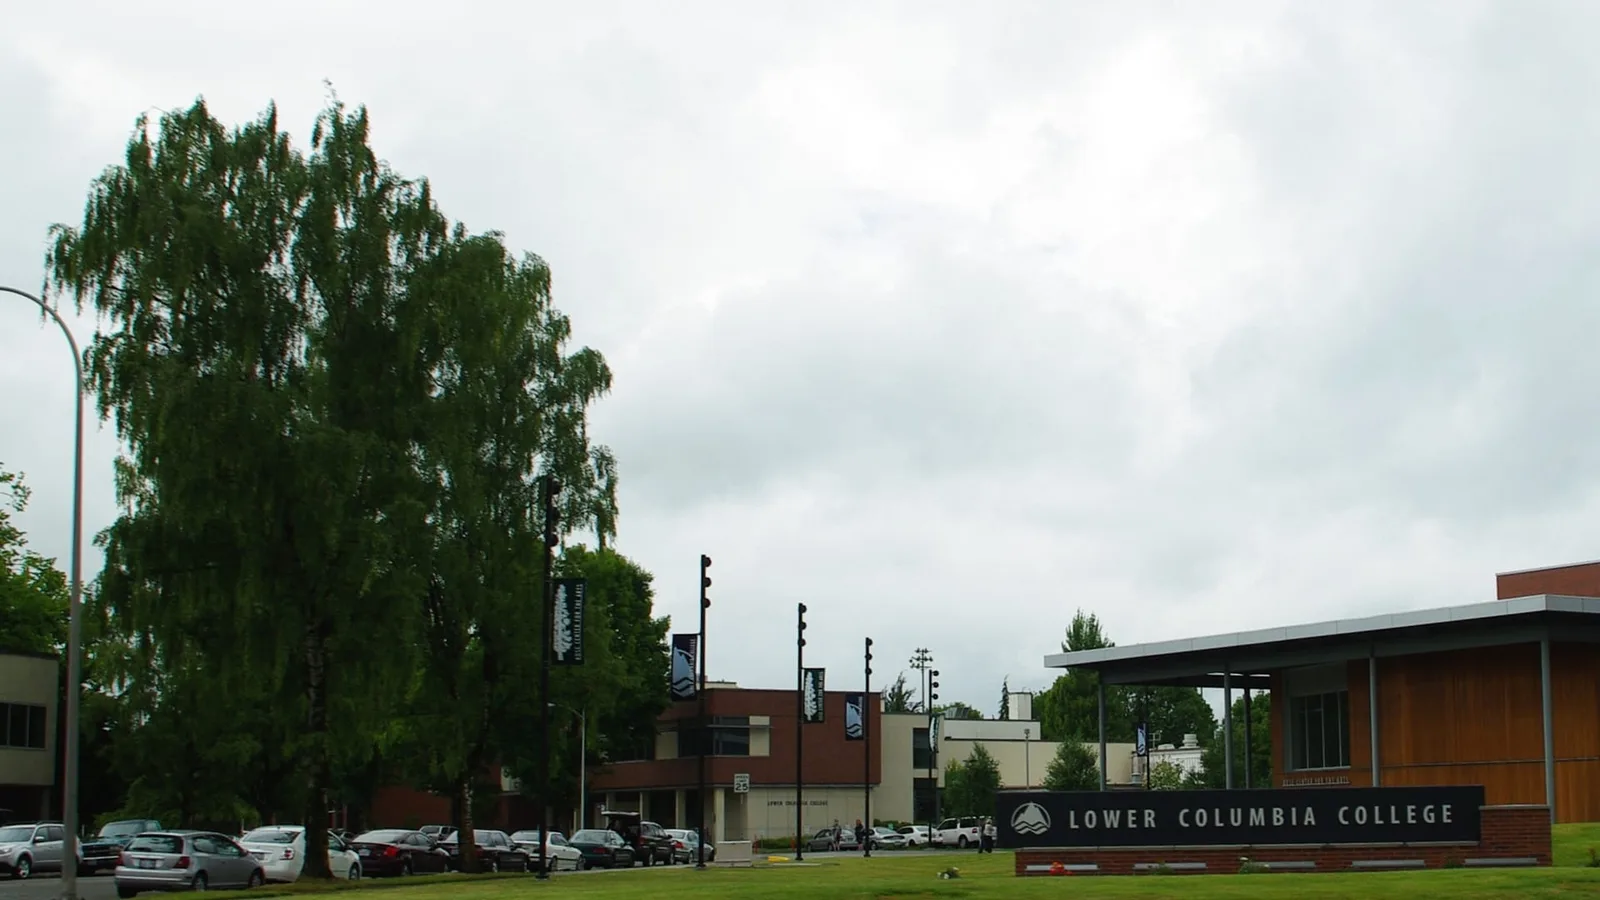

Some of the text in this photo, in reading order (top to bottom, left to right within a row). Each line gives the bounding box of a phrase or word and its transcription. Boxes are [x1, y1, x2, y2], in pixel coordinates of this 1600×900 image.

[735, 783, 749, 791] 25
[1069, 804, 1453, 829] LOWER COLUMBIA COLLEGE
